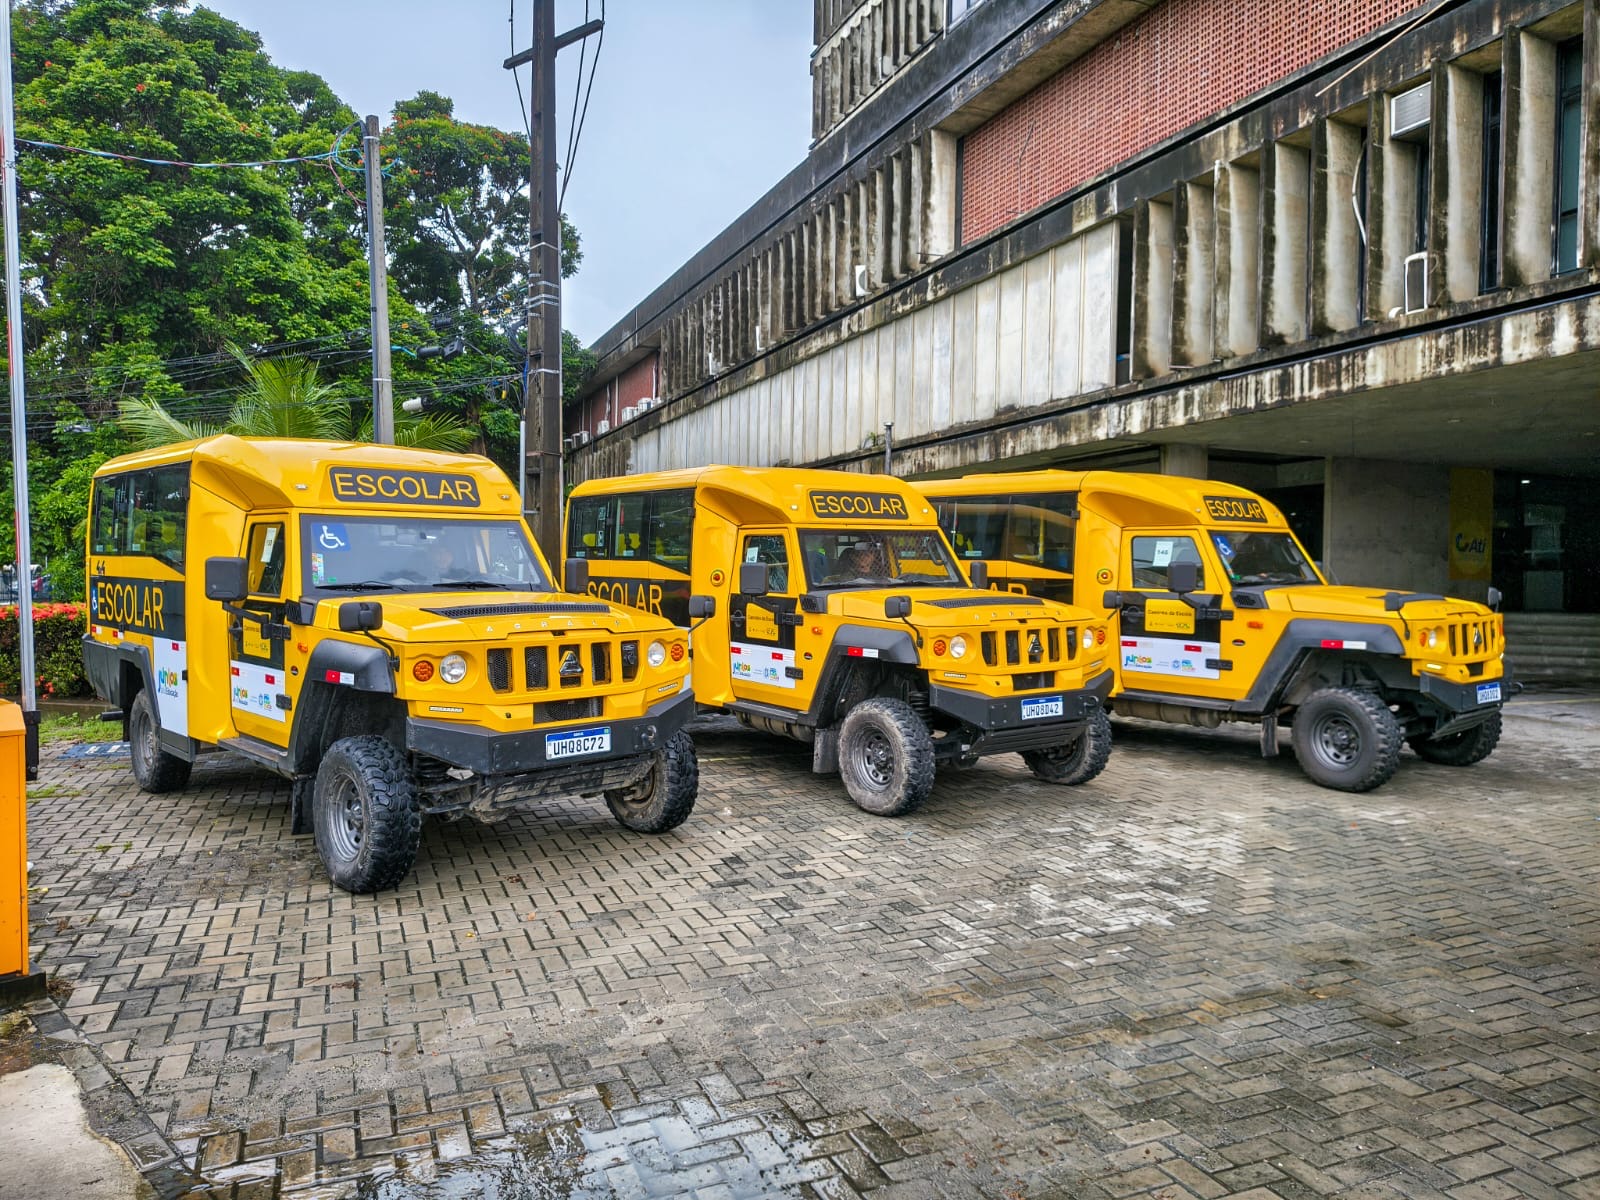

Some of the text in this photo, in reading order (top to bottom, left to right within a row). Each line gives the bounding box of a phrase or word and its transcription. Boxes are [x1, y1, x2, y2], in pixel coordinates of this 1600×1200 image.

[334, 473, 476, 502] ESCOLAR
[812, 495, 905, 516] ESCOLAR
[1208, 499, 1264, 519] ESCOLAR
[97, 582, 164, 631] ESCOLAR
[587, 580, 663, 618] SCOLAR
[553, 736, 604, 755] UHQ8C72
